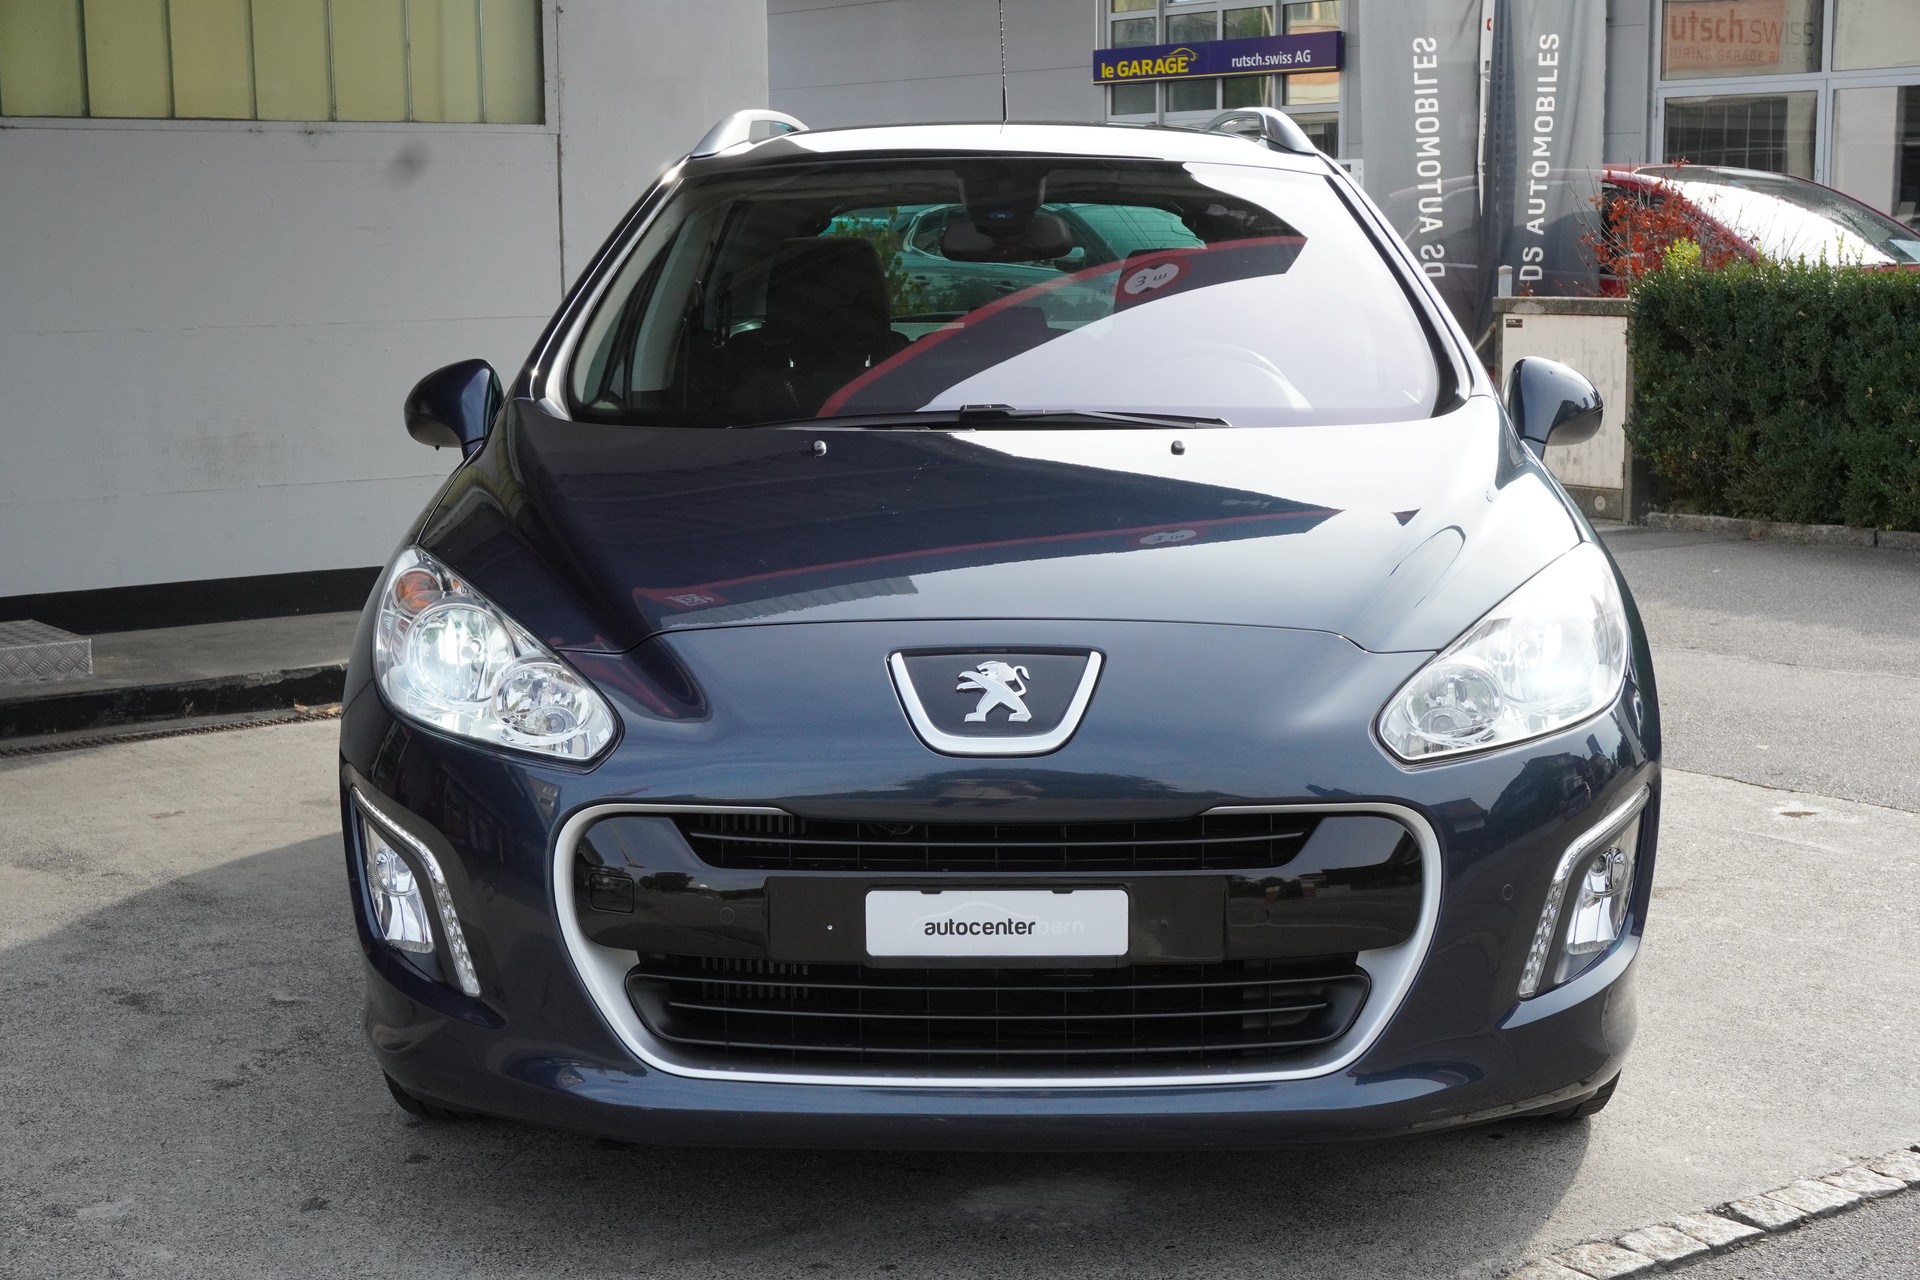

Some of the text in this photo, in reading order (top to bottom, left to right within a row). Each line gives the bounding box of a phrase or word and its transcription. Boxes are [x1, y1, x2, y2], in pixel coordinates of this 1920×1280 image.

[1671, 9, 1815, 47] utsch.swiss
[1231, 49, 1311, 68] rutsch.swiss AG
[1670, 47, 1712, 61] URING
[1717, 49, 1765, 63] GARAGE
[1101, 56, 1189, 78] le GARAGE
[1519, 33, 1559, 281] DS AUTOMOBILES
